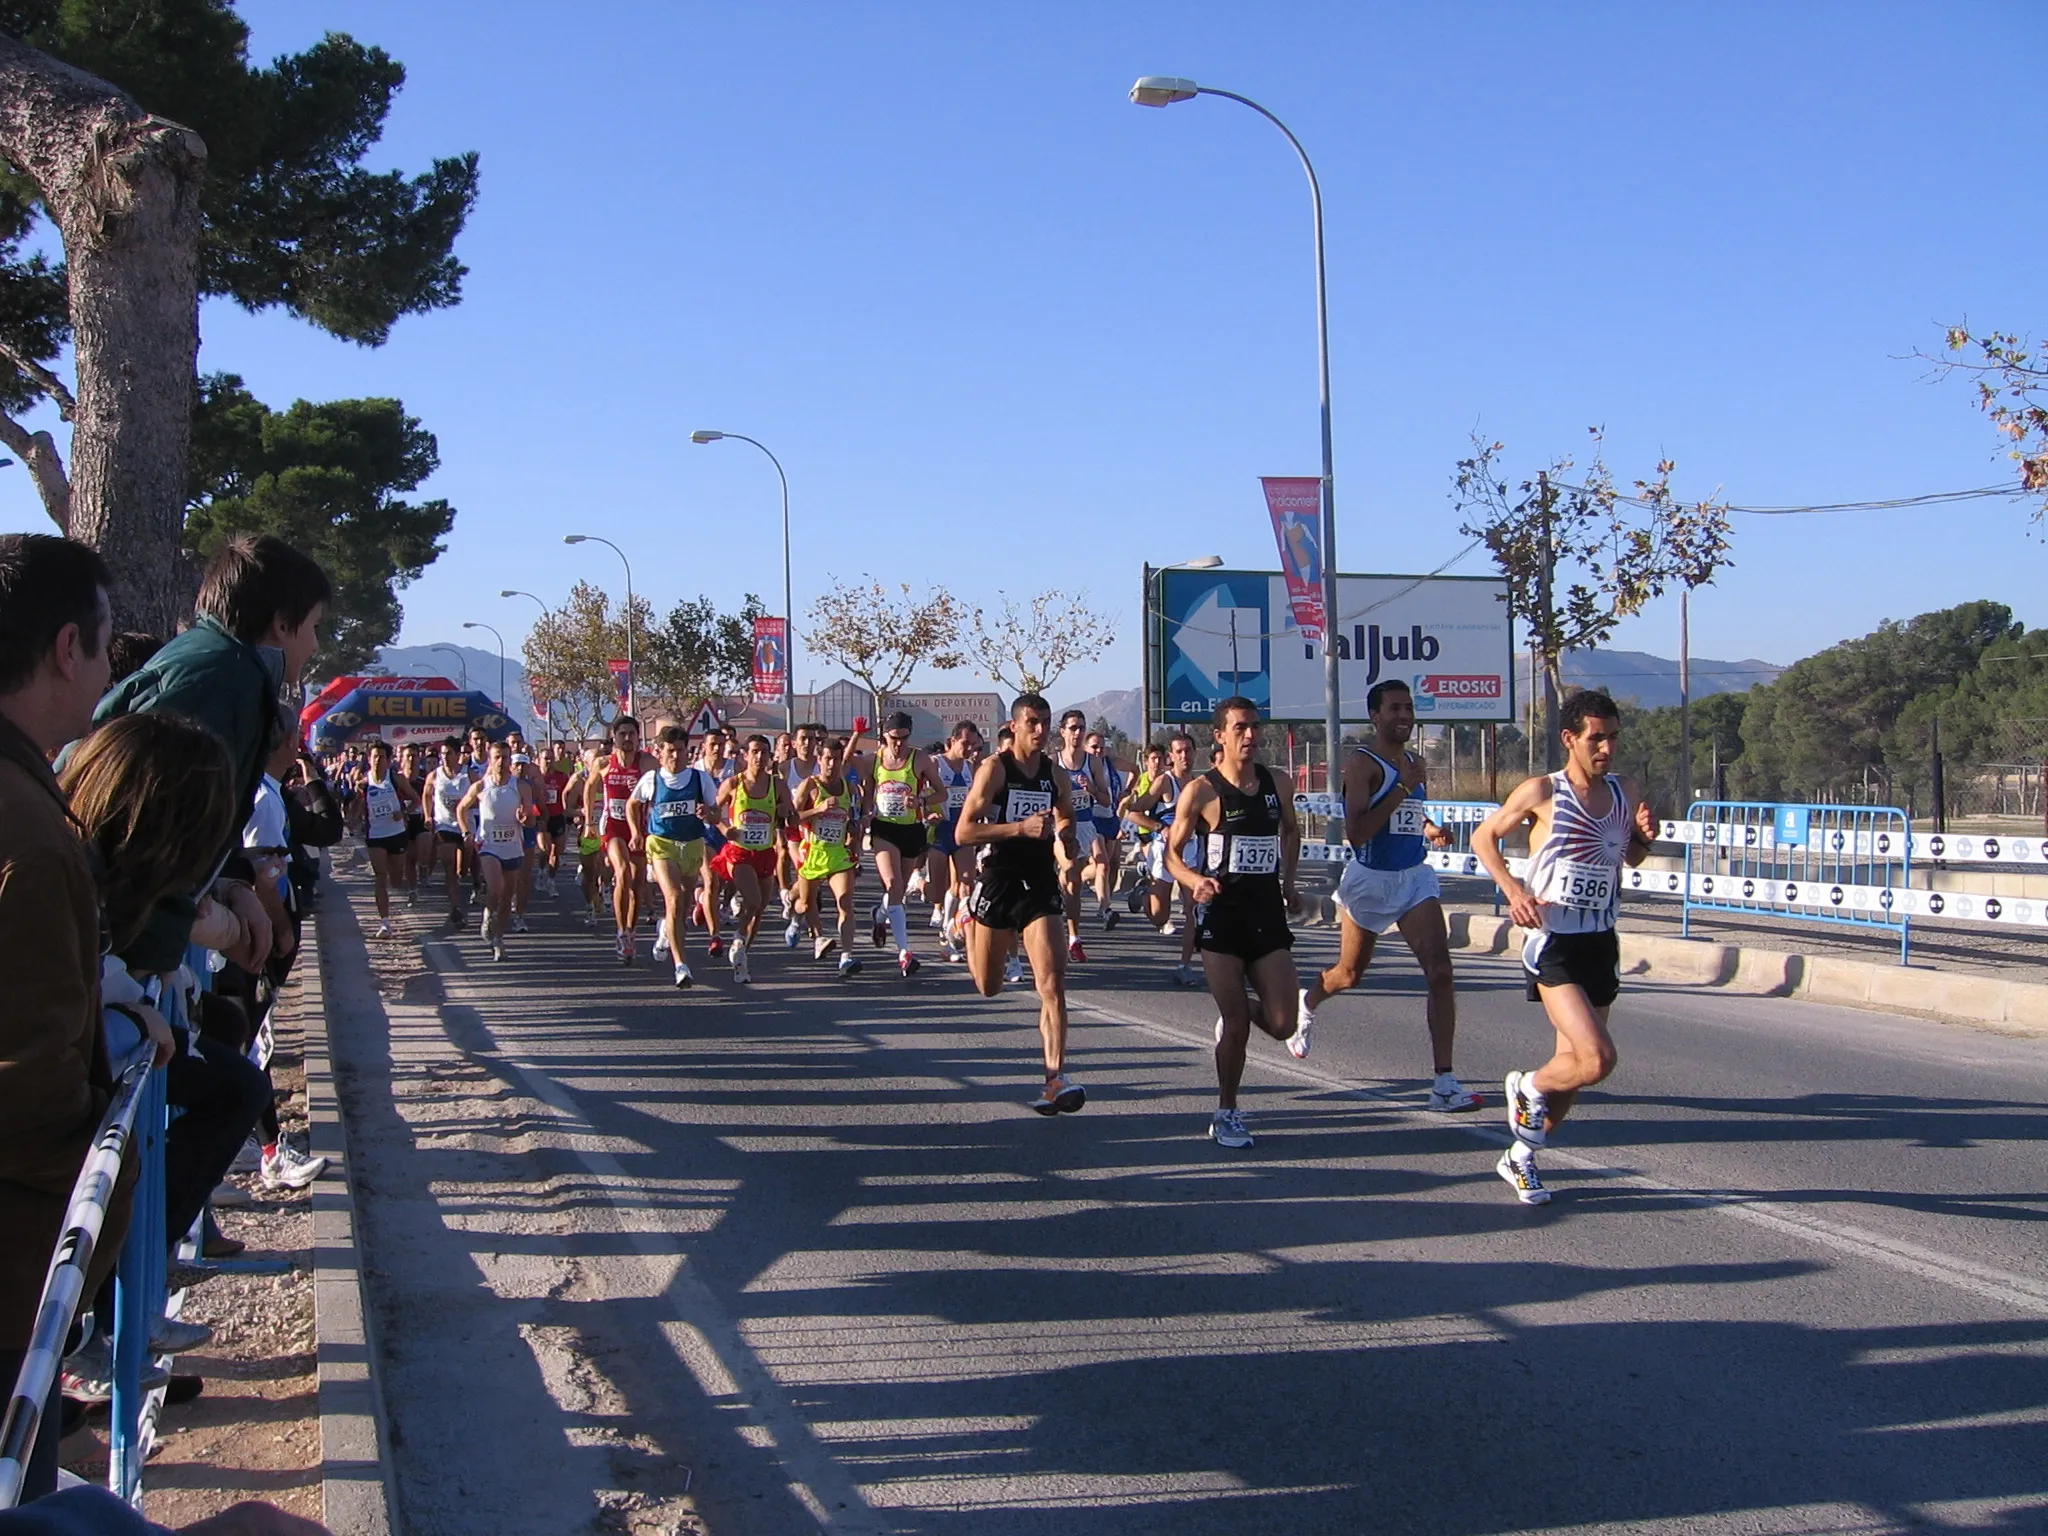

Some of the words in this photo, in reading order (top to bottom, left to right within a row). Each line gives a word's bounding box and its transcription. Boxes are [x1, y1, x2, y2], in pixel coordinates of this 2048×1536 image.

[368, 696, 468, 718] KELME
[884, 699, 928, 709] ABELLON
[934, 698, 991, 708] DEPORTIVO
[1181, 700, 1201, 713] en
[940, 713, 990, 722] MUNICIPAL
[744, 830, 768, 840] 1221
[818, 827, 842, 838] 1223
[1237, 848, 1275, 864] 1376
[1560, 875, 1609, 898] 1586
